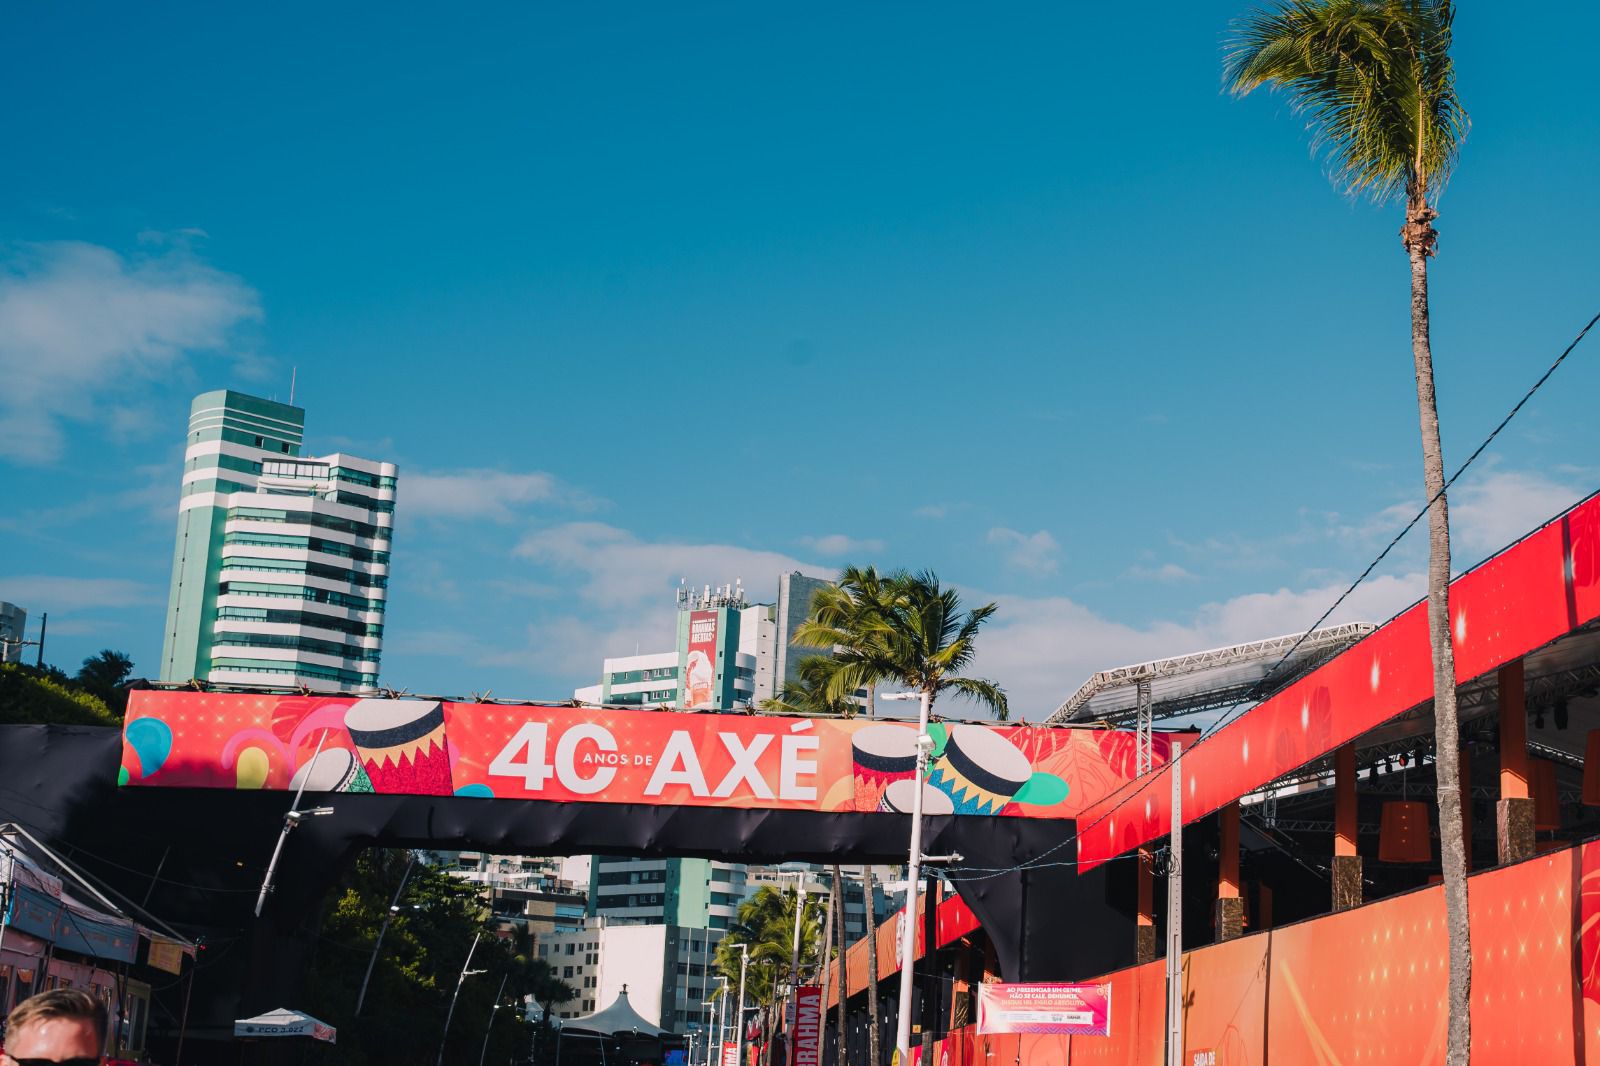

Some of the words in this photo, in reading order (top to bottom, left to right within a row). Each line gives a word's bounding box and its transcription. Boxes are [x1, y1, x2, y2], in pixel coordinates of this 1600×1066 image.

[488, 721, 618, 794] 40
[582, 752, 629, 765] ANOS
[634, 754, 653, 766] DE
[643, 718, 820, 801] AXÉ
[797, 994, 820, 1066] RAHMA
